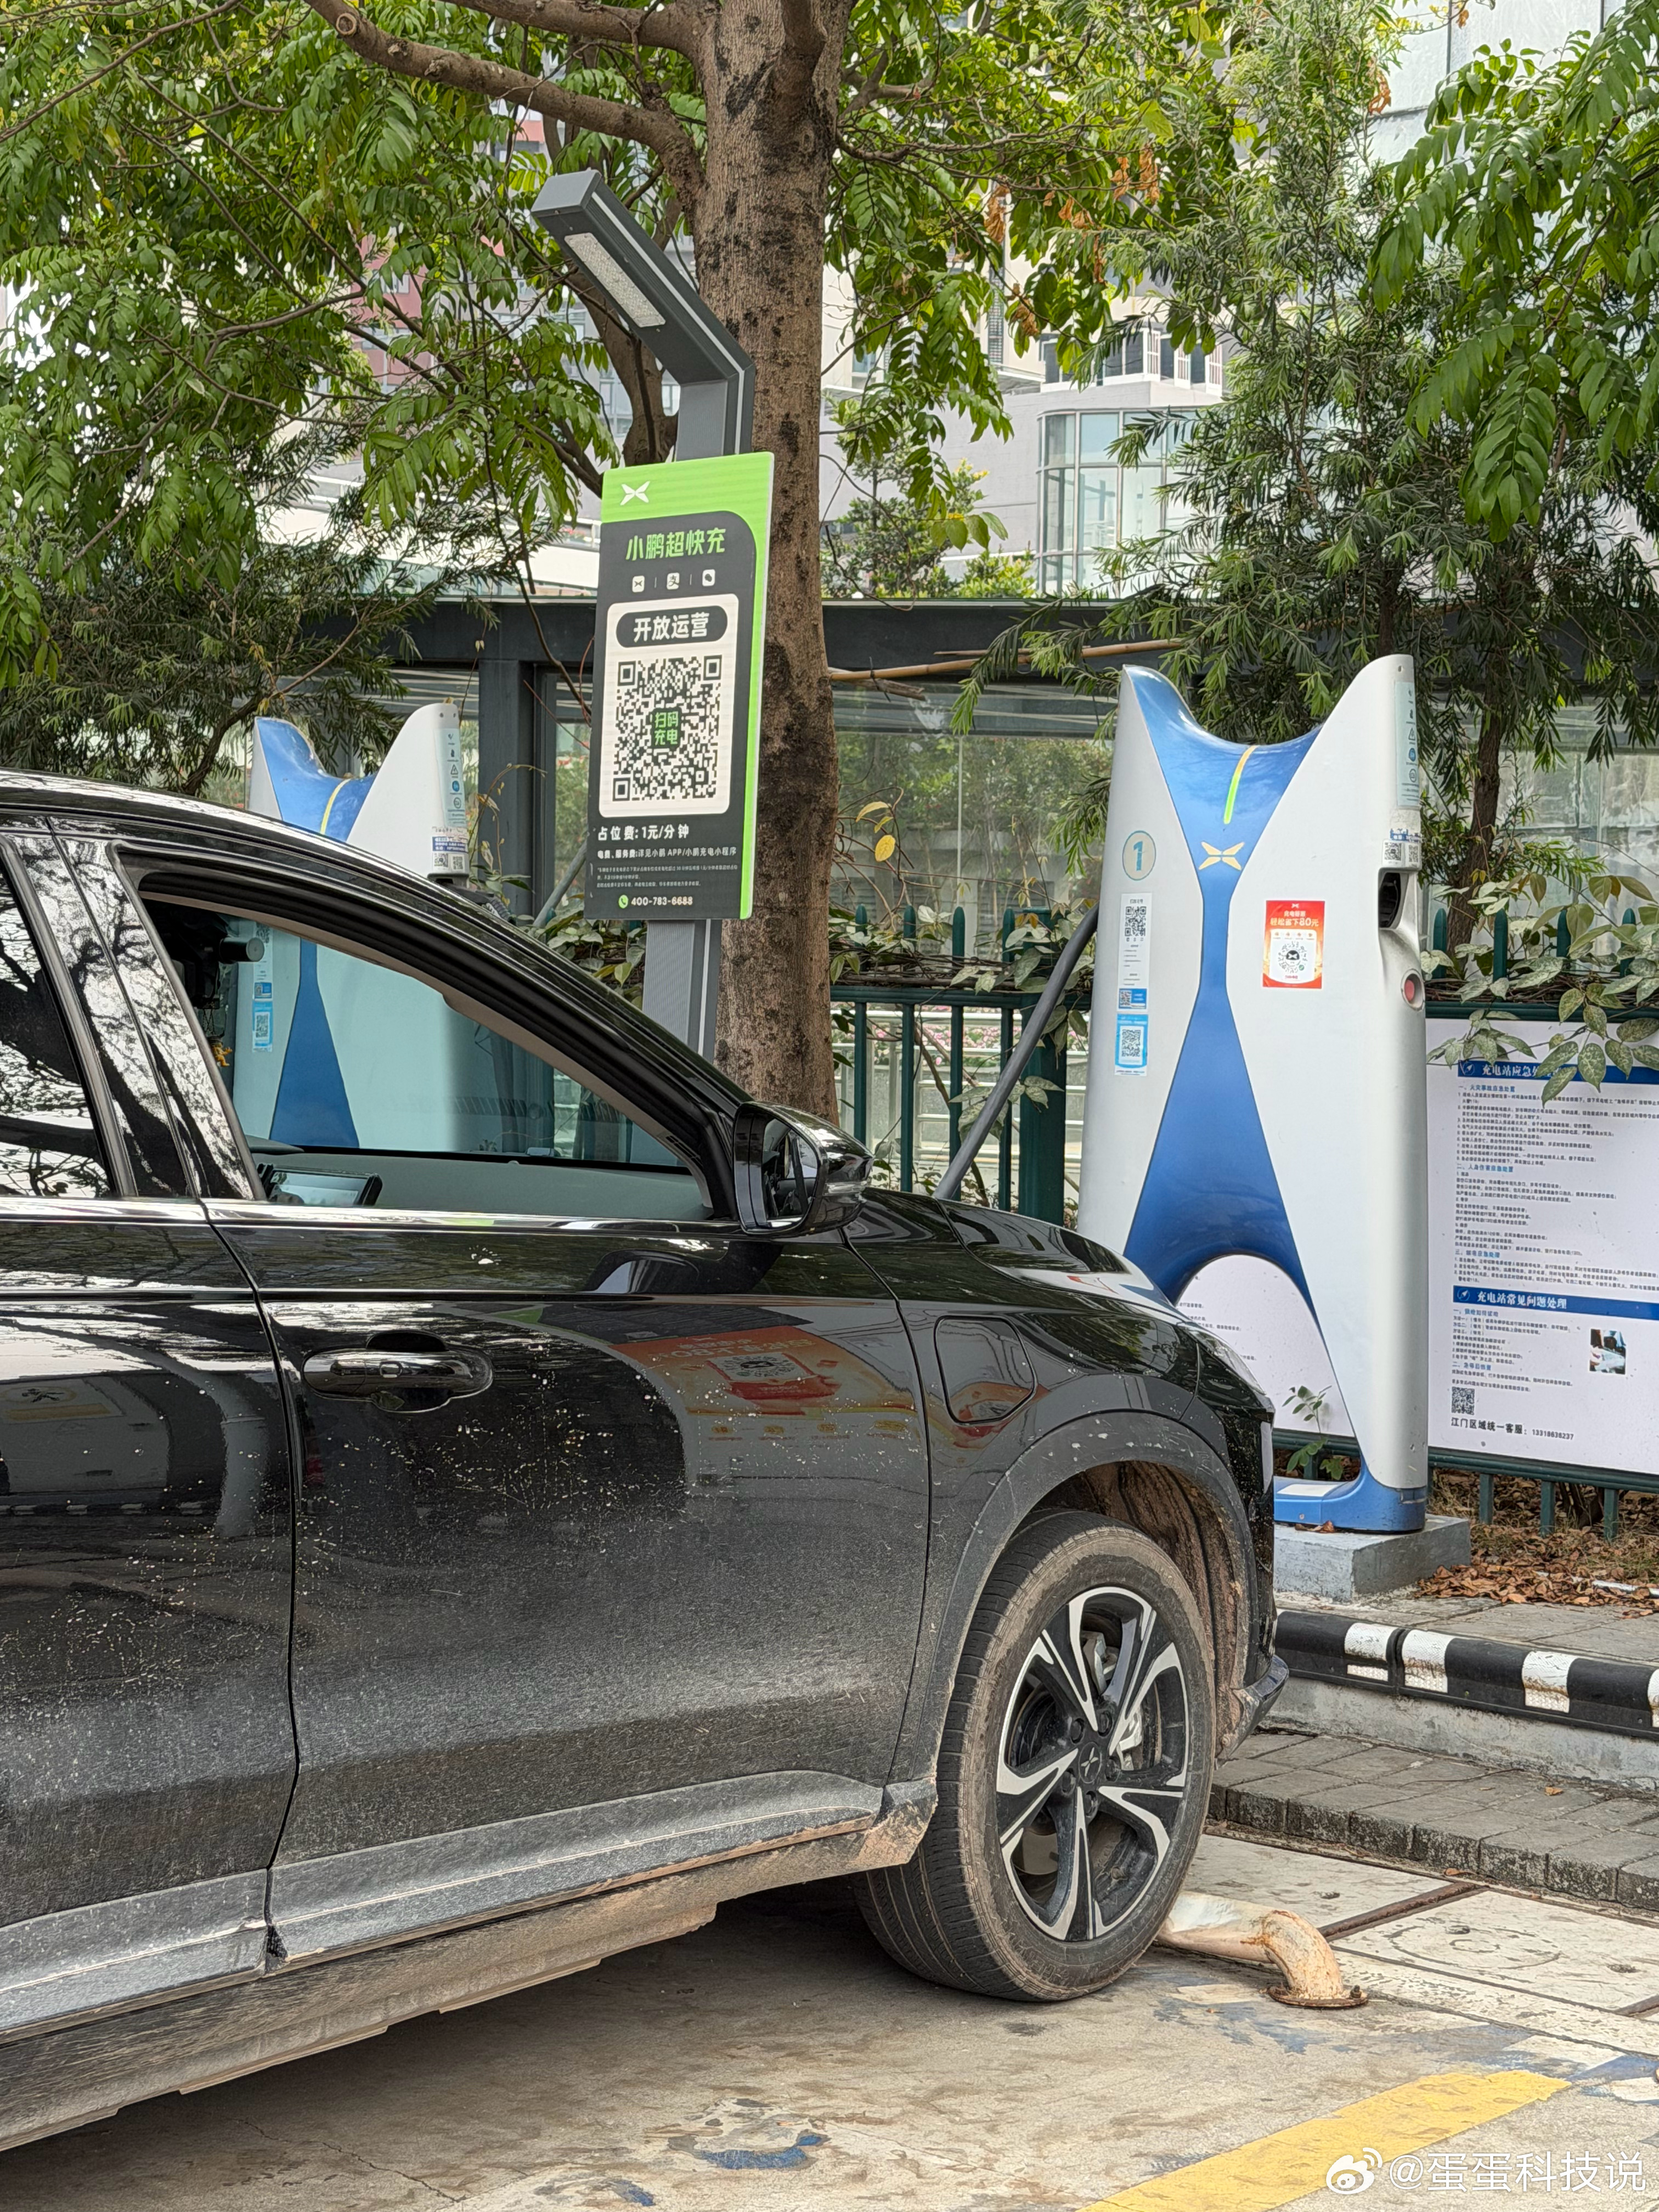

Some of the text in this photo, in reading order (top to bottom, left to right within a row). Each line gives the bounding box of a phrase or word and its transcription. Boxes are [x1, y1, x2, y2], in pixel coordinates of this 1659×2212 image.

[625, 527, 726, 561] 小鹏超快充
[633, 612, 710, 643] 开放运营
[654, 711, 679, 728] 扫码
[654, 729, 678, 746] 充电
[1133, 840, 1143, 871] 1
[631, 896, 693, 906] 400-783-6688
[1477, 1290, 1567, 1310] 充电站常见问题处理
